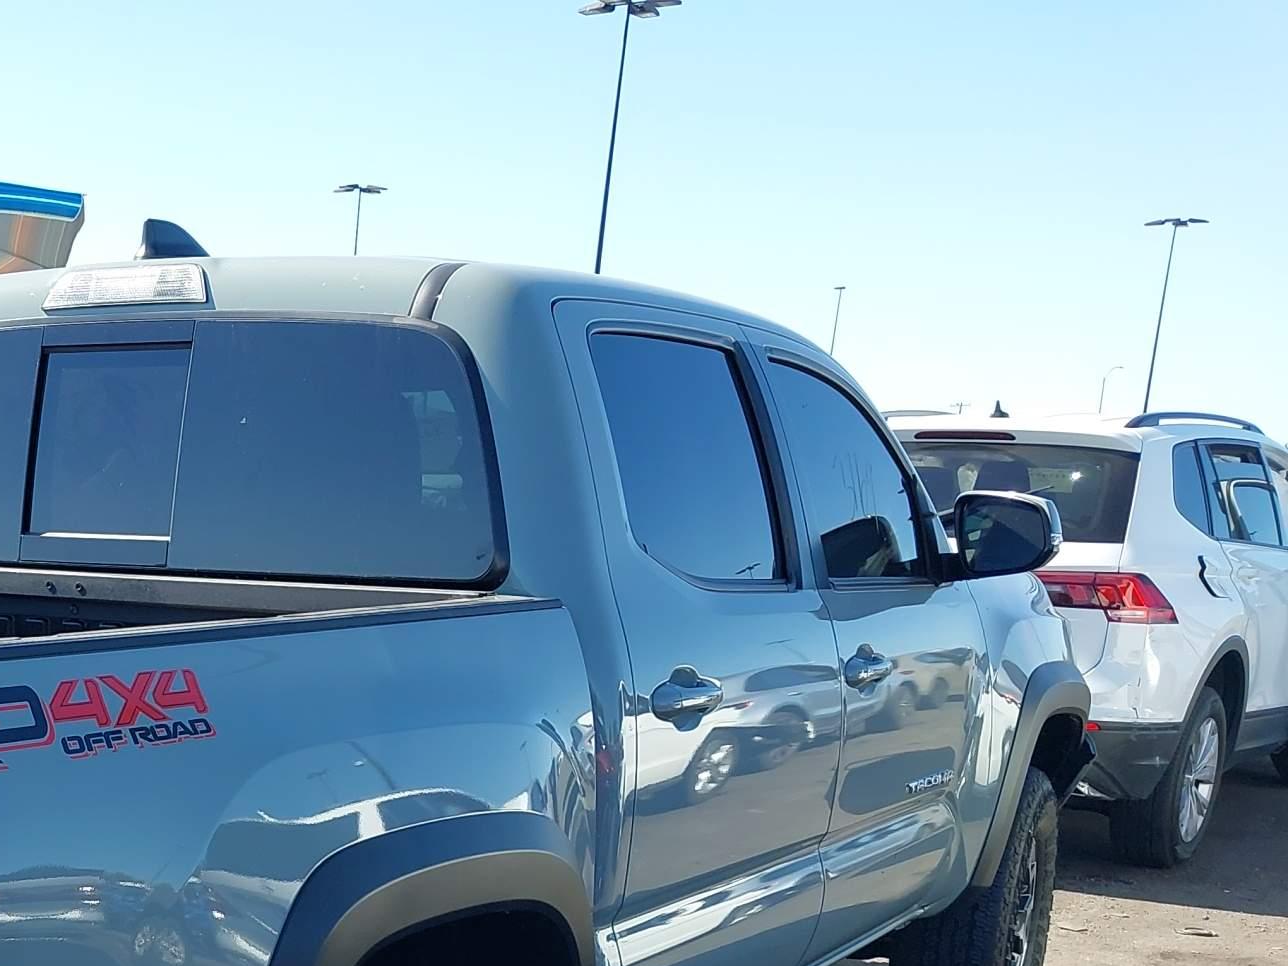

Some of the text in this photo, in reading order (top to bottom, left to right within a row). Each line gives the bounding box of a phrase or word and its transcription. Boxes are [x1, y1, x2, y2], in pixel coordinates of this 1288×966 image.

[49, 668, 209, 728] 4X4
[61, 717, 216, 759] OFF ROAD
